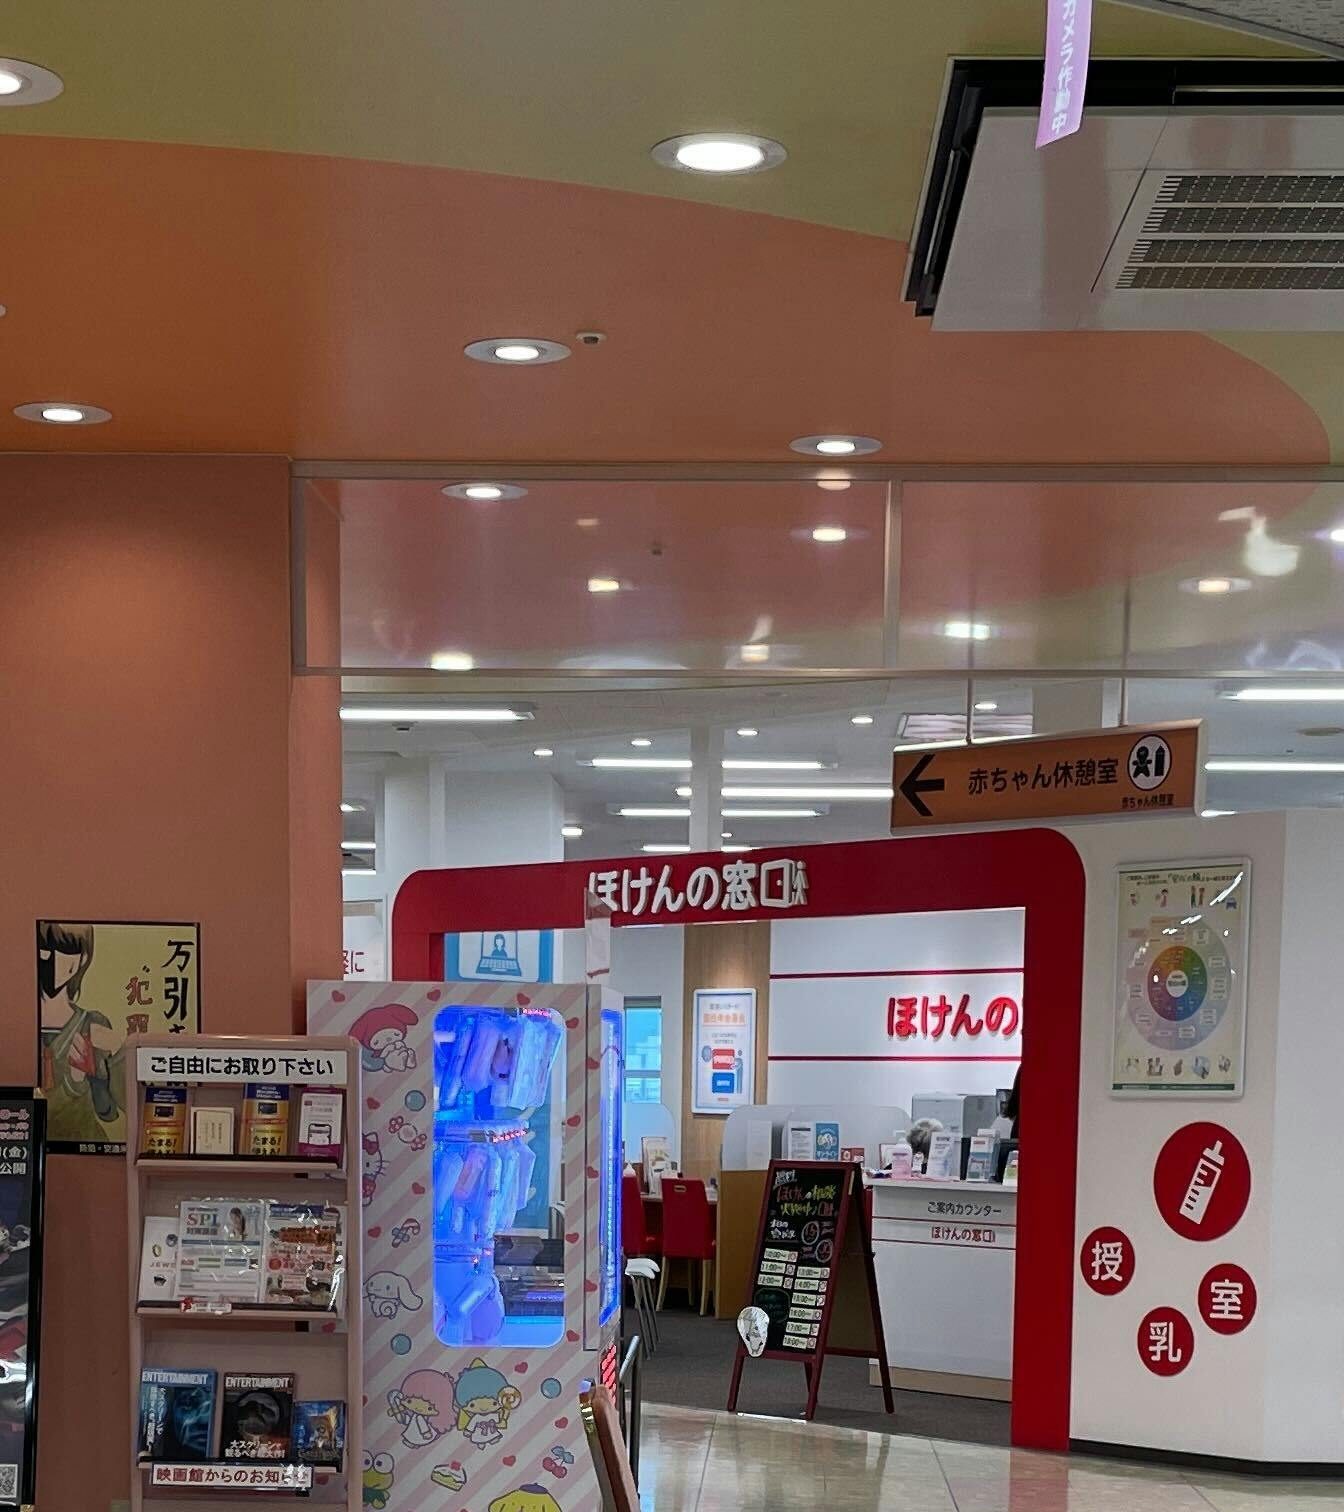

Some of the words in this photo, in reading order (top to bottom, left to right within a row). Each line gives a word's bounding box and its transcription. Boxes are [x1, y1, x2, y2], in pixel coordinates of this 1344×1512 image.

[967, 757, 1119, 795] 赤ちゃん休憩室
[588, 858, 798, 916] ほけんの窓口
[887, 993, 1019, 1038] ほけんの
[150, 1055, 335, 1077] ご自由にお取り下さい
[927, 1201, 1002, 1217] ご案内カウンター
[931, 1226, 996, 1243] ほけんの窓口
[1090, 1240, 1123, 1282] 授
[1148, 1321, 1182, 1363] 乳
[1209, 1278, 1244, 1320] 室
[156, 1467, 309, 1485] 映画館からのお知ら
